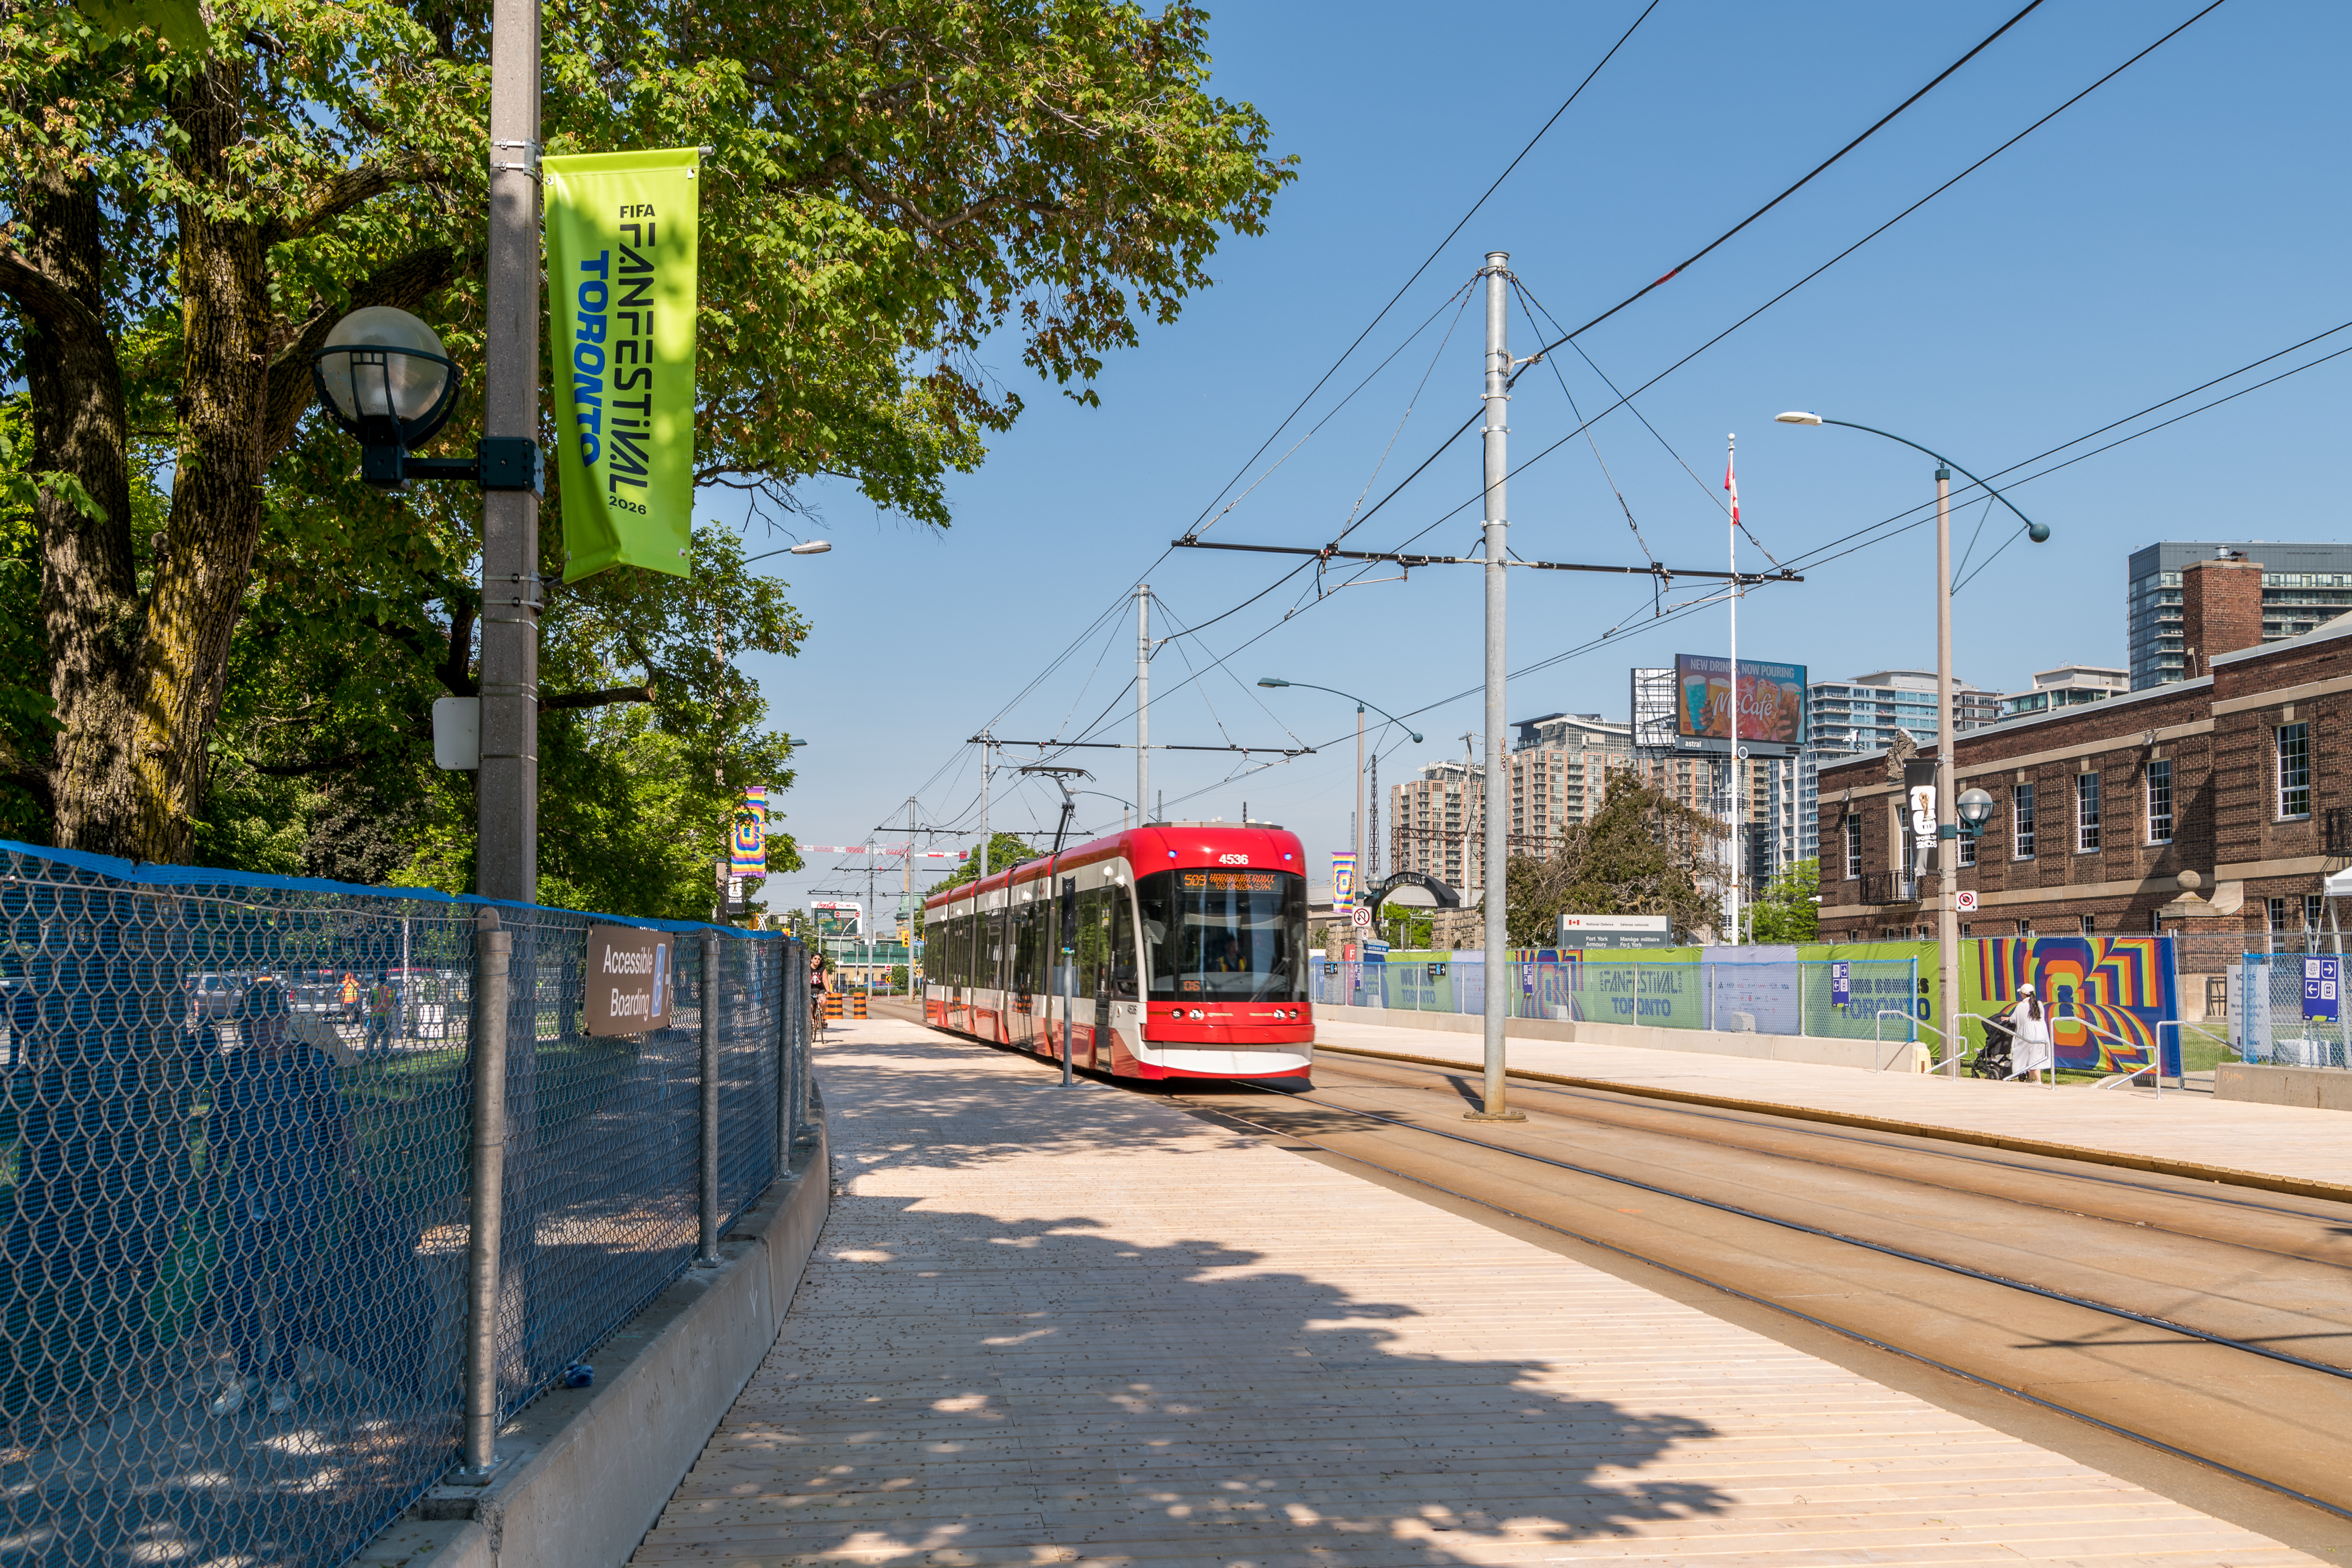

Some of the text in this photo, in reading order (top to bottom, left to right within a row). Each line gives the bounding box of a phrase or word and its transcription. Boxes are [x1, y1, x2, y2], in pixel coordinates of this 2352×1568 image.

[619, 204, 655, 218] FIFA
[573, 250, 609, 468] TORONTO
[609, 496, 647, 515] 2026
[1691, 659, 1708, 671] NEW
[1742, 664, 1760, 675] NOW
[1761, 665, 1794, 679] POURING
[1219, 854, 1249, 865] 4536
[1184, 874, 1207, 886] 509
[603, 945, 653, 974] Accessible
[1400, 968, 1414, 986] WE
[610, 988, 650, 1021] Boarding
[1402, 989, 1436, 1004] TORONTO
[1612, 997, 1671, 1017] TORONTO
